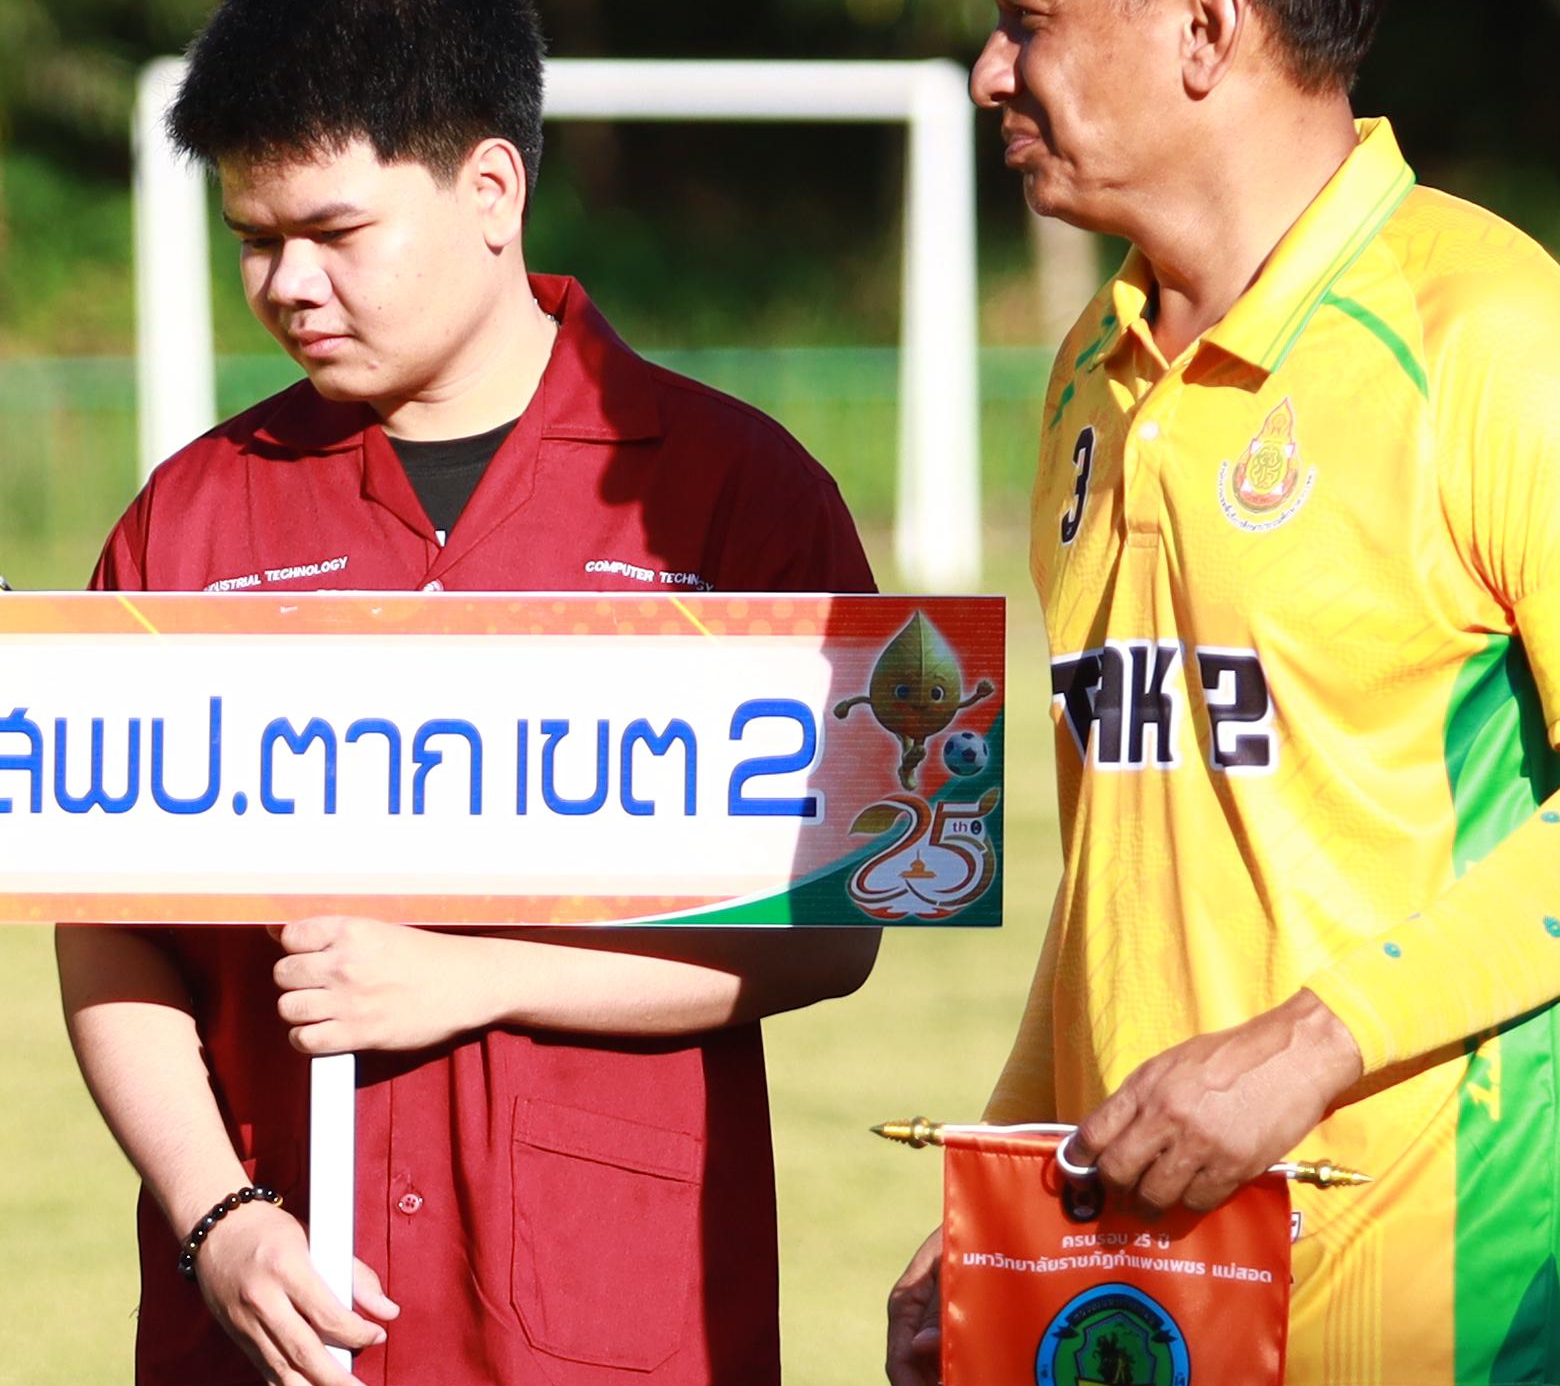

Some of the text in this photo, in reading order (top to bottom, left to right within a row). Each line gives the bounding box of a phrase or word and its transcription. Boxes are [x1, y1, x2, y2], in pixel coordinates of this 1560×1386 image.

[1061, 427, 1095, 544] 3
[265, 556, 349, 581] TECHNOLOGY
[585, 560, 655, 582] COMPUTER
[1050, 641, 1273, 772] TAK 2
[516, 717, 699, 816] เขต
[727, 697, 820, 818] 2
[1061, 1232, 1128, 1249] ครบรอบ
[1133, 1232, 1151, 1248] 25
[1211, 1259, 1273, 1283] แม่สอด
